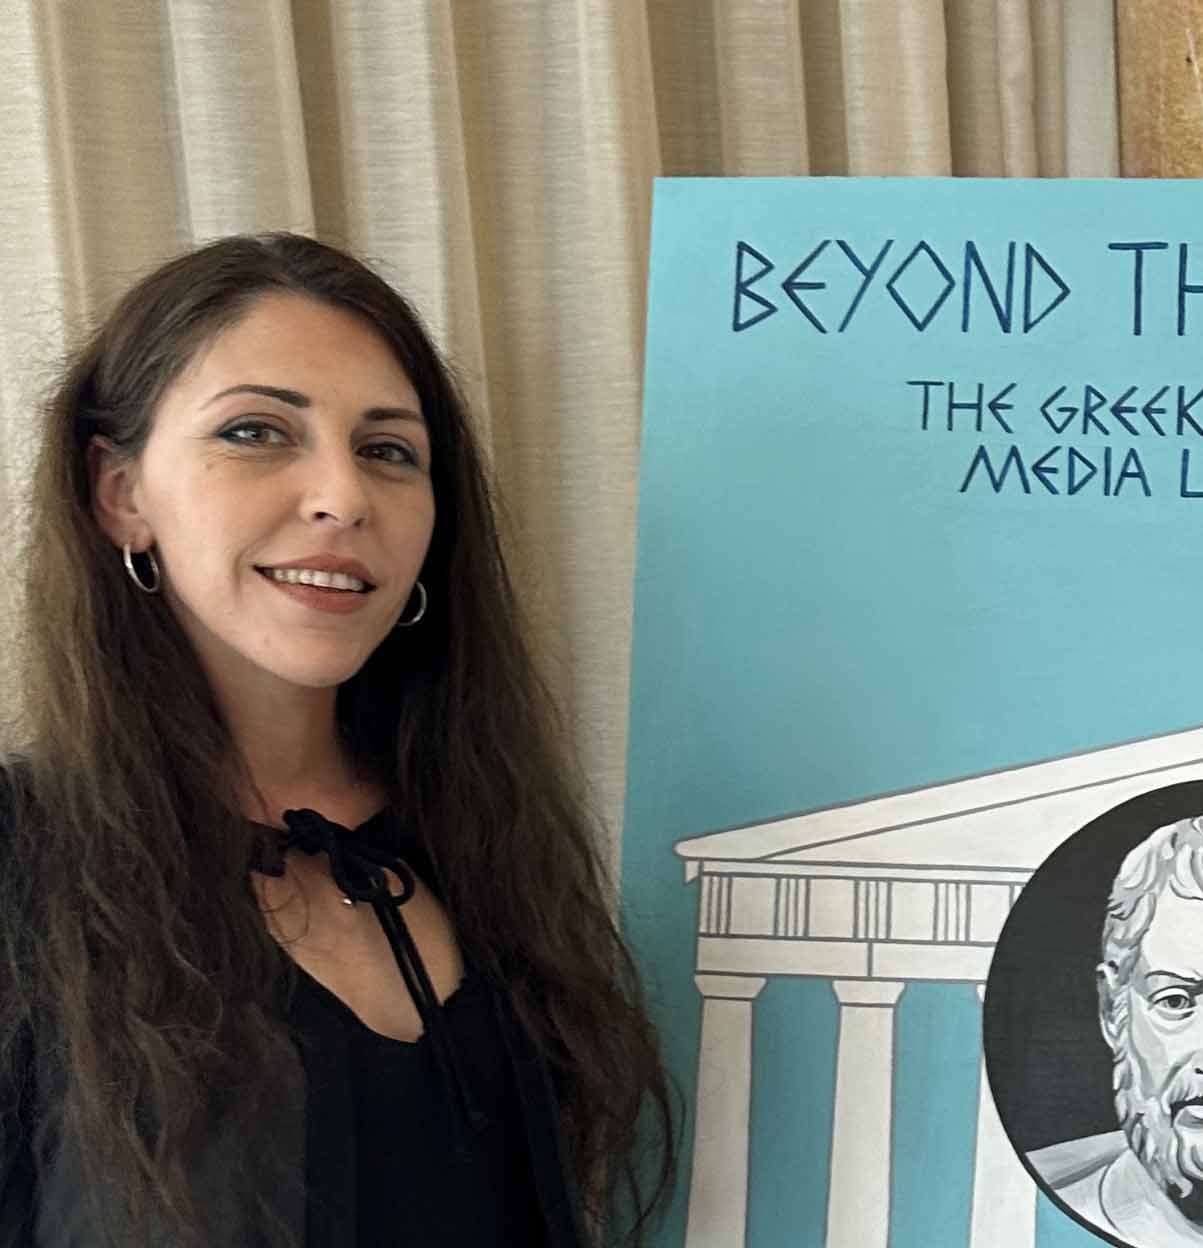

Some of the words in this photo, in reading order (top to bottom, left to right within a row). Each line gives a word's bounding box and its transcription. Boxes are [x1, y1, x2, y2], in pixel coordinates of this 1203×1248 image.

[733, 239, 1071, 335] BEYOND
[906, 380, 1017, 434] THE
[959, 445, 1152, 497] MEDIA
